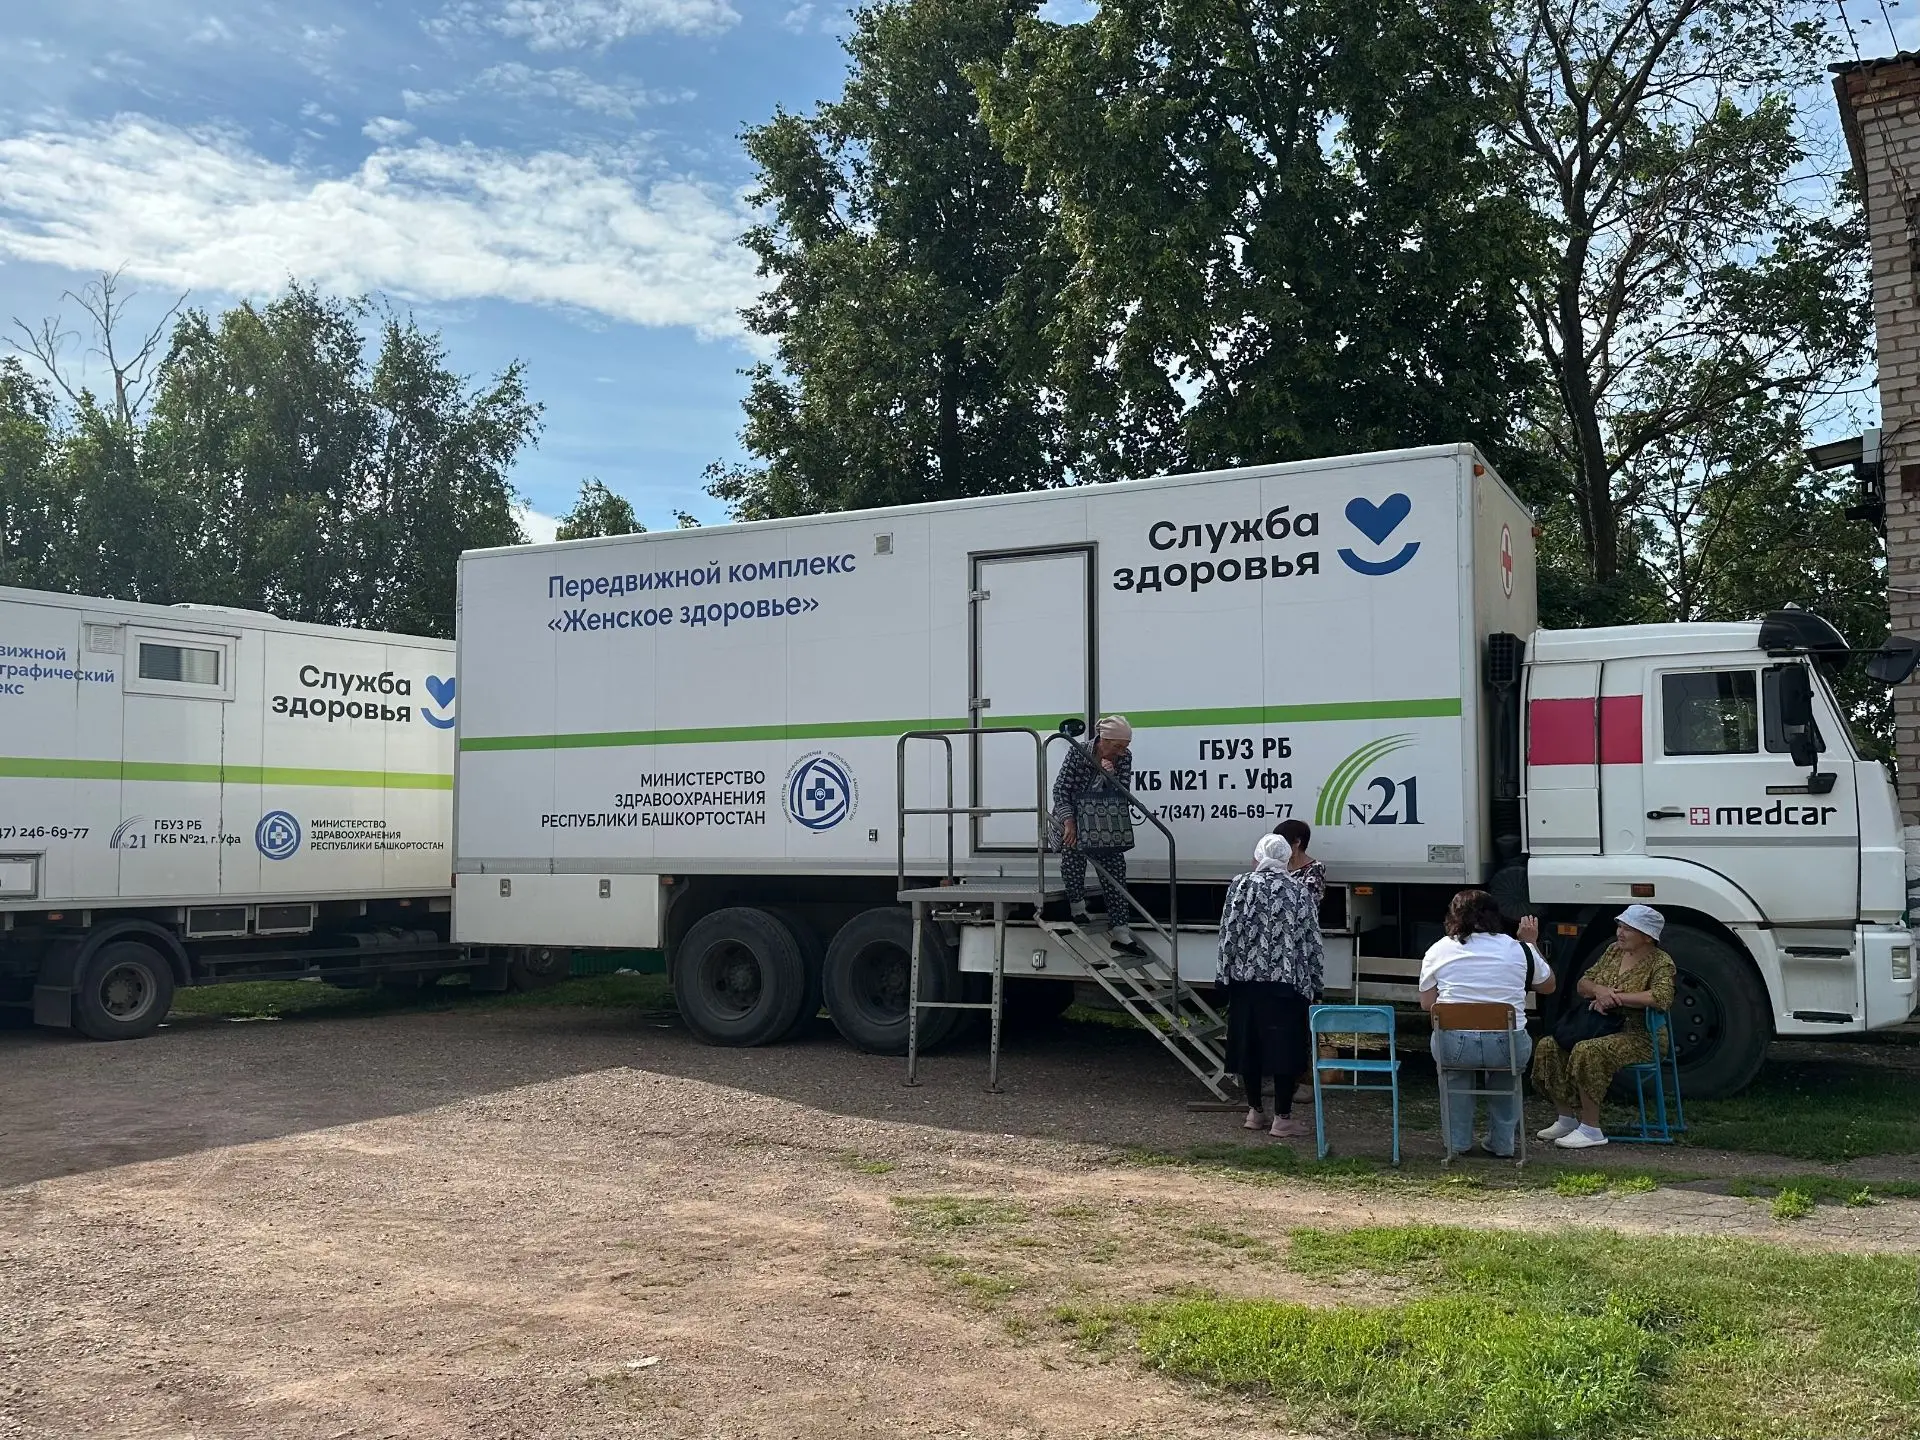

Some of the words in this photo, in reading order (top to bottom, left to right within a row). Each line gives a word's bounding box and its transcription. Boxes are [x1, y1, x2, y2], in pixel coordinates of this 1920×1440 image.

[1148, 505, 1320, 554] Служба
[548, 560, 722, 601] Передвижной
[728, 553, 857, 586] комплекс
[1113, 551, 1320, 592] здоровья
[547, 604, 676, 633] «Женское
[679, 596, 819, 629] здоровье»
[299, 665, 411, 696] Служба
[271, 695, 411, 722] здоровья
[1198, 737, 1255, 762] ГБУЗ
[1261, 736, 1293, 760] РБ
[640, 771, 766, 787] МИНИСТЕРСТВО
[1169, 768, 1208, 792] N21
[1217, 772, 1237, 791] г.
[1244, 767, 1294, 794] Уфа
[614, 790, 766, 808] ЗДРАВООХРАНЕНИЯ
[540, 814, 638, 829] РЕСПУБЛИКИ
[640, 810, 766, 828] БАШКОРТОСТАН
[1152, 804, 1205, 822] +7(347)
[1209, 803, 1294, 820] 246-69-77
[1716, 800, 1837, 825] medcar
[19, 826, 90, 839] 246-69-77
[153, 820, 184, 830] ГБУЗ
[187, 820, 202, 830] РБ
[310, 819, 387, 828] МИНИСТЕРСТВО
[153, 833, 178, 845] ГКБ
[310, 830, 401, 839] ЗДРАВООХРАНЕНИЯ
[310, 842, 373, 851] РЕСПУБЛИКИ
[374, 841, 444, 850] БАШКОРТОСТАН
